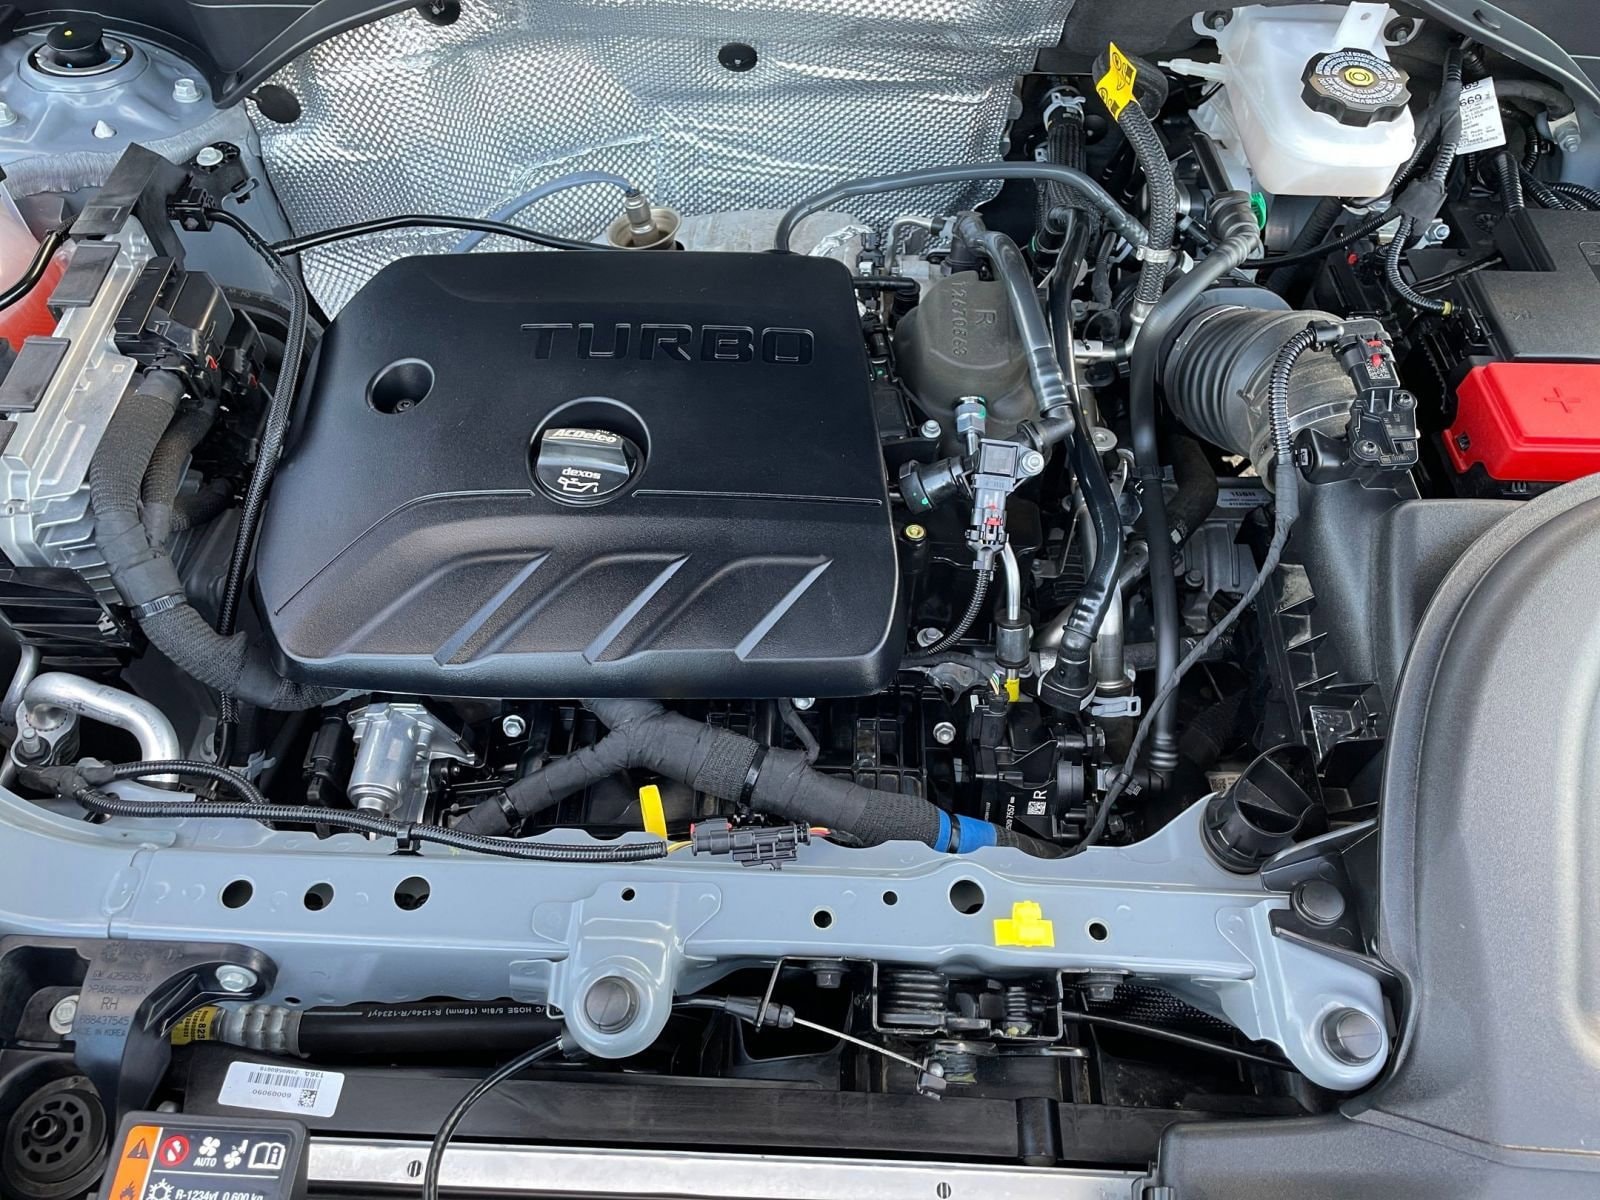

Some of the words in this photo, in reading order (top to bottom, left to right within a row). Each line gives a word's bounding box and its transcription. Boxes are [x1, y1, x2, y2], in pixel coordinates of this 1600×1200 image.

[975, 309, 997, 325] R
[521, 323, 815, 365] TURBO
[552, 429, 618, 443] ACDelco
[562, 467, 602, 480] dexos
[1033, 790, 1048, 800] R
[100, 997, 120, 1010] RH
[445, 1007, 478, 1015] (16mm)
[482, 1007, 504, 1015] 5/8in
[305, 1070, 324, 1079] 136A
[193, 1157, 218, 1167] AUTO
